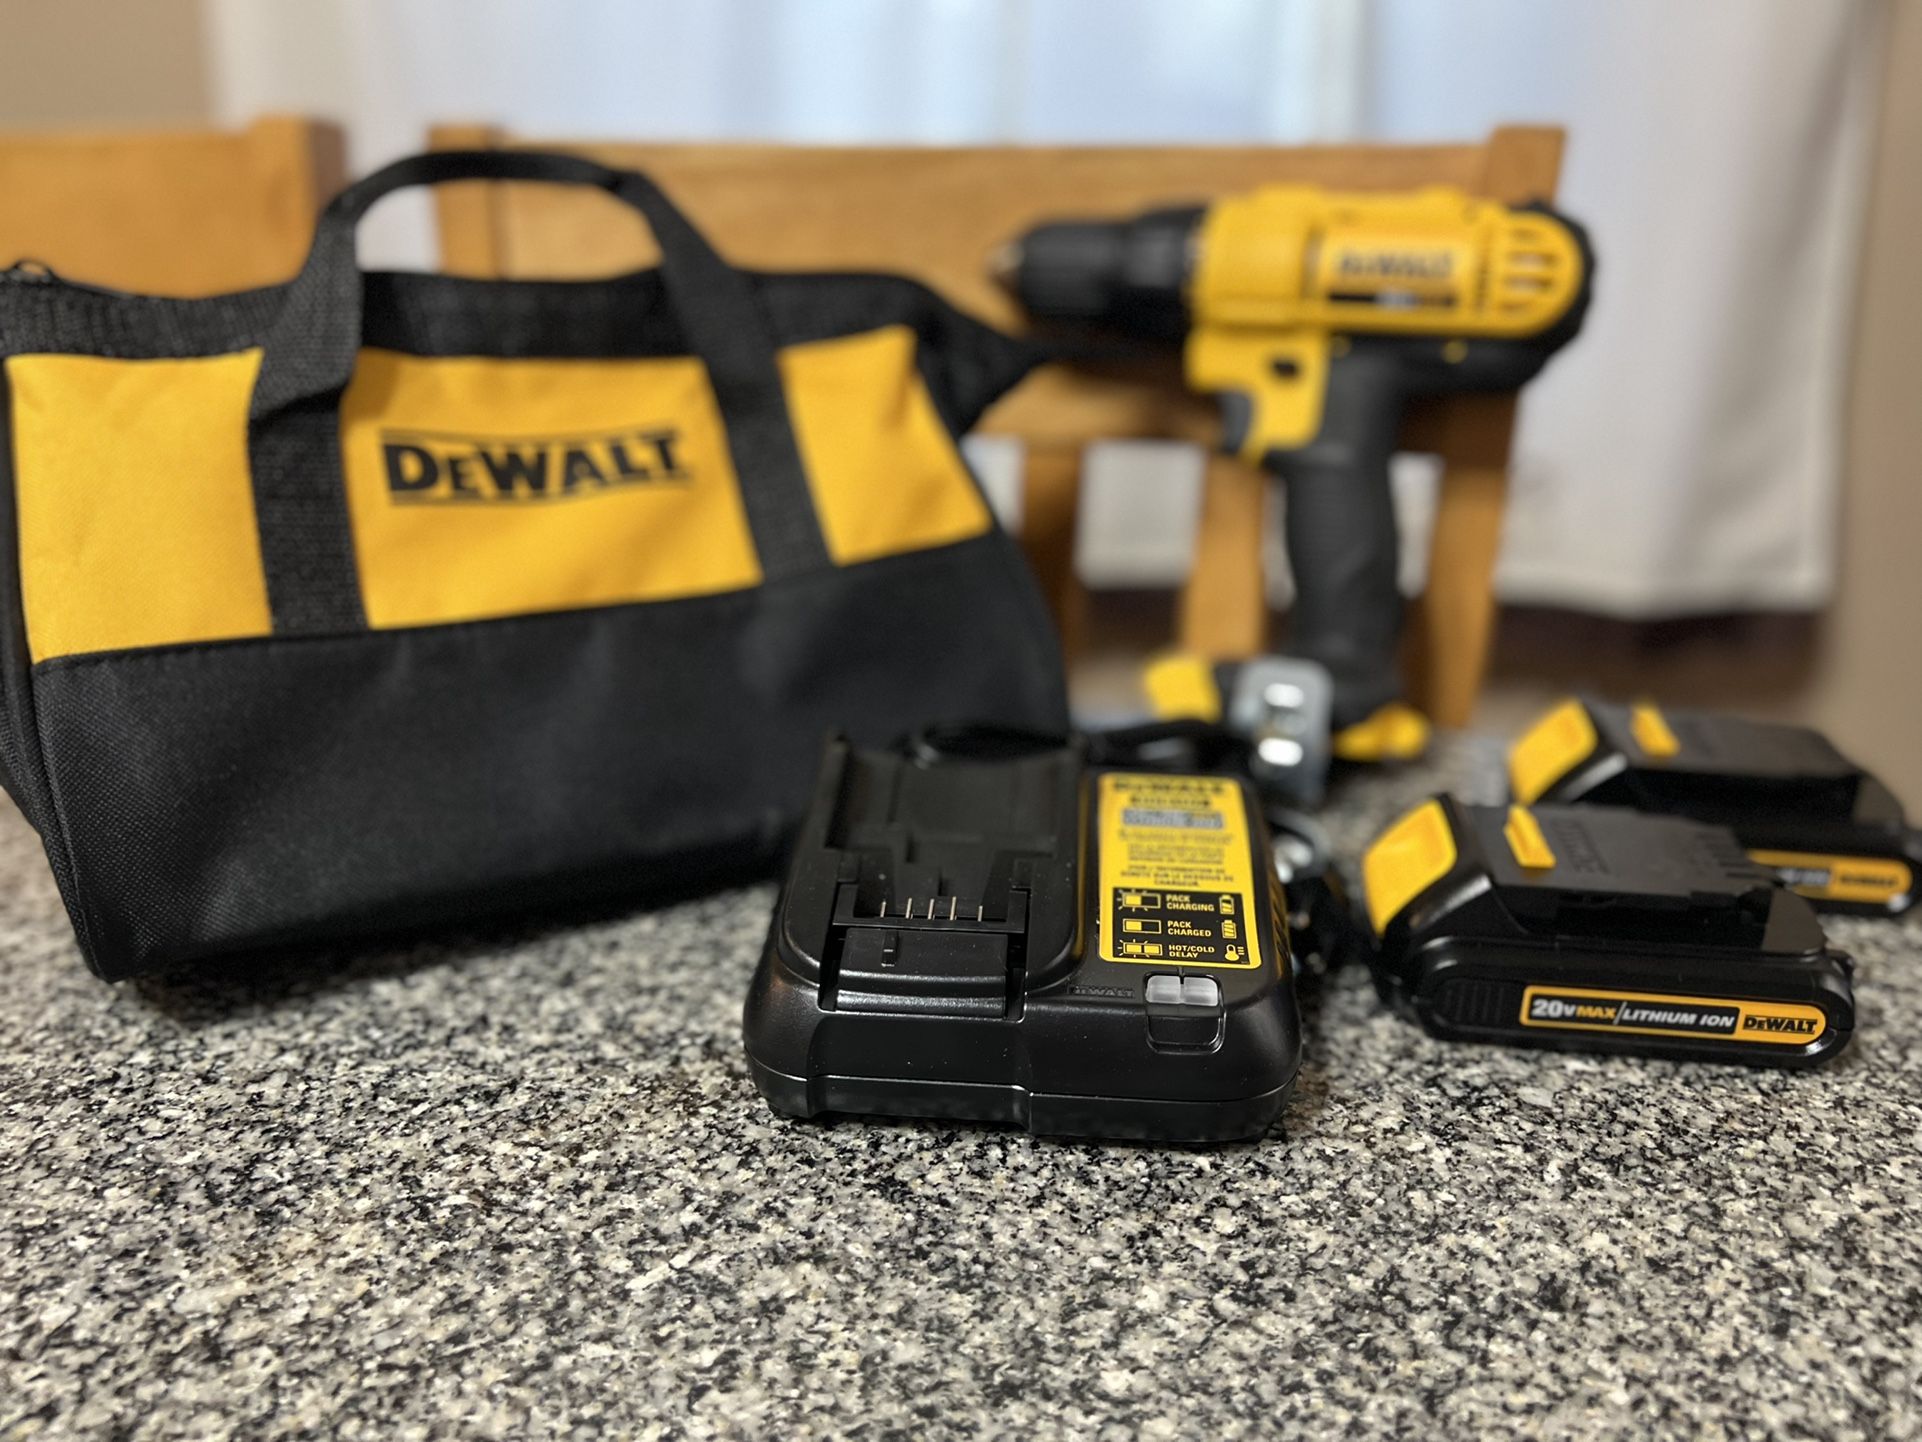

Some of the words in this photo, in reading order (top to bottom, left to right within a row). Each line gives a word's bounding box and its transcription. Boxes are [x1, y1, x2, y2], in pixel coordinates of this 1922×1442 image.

[1166, 895, 1190, 903] PACK
[1166, 903, 1215, 912] CHARGING
[1167, 920, 1192, 928] PACK
[1167, 928, 1212, 937] CHARGED
[1168, 945, 1215, 953] HOT/COLD
[1699, 1013, 1735, 1028] ION
